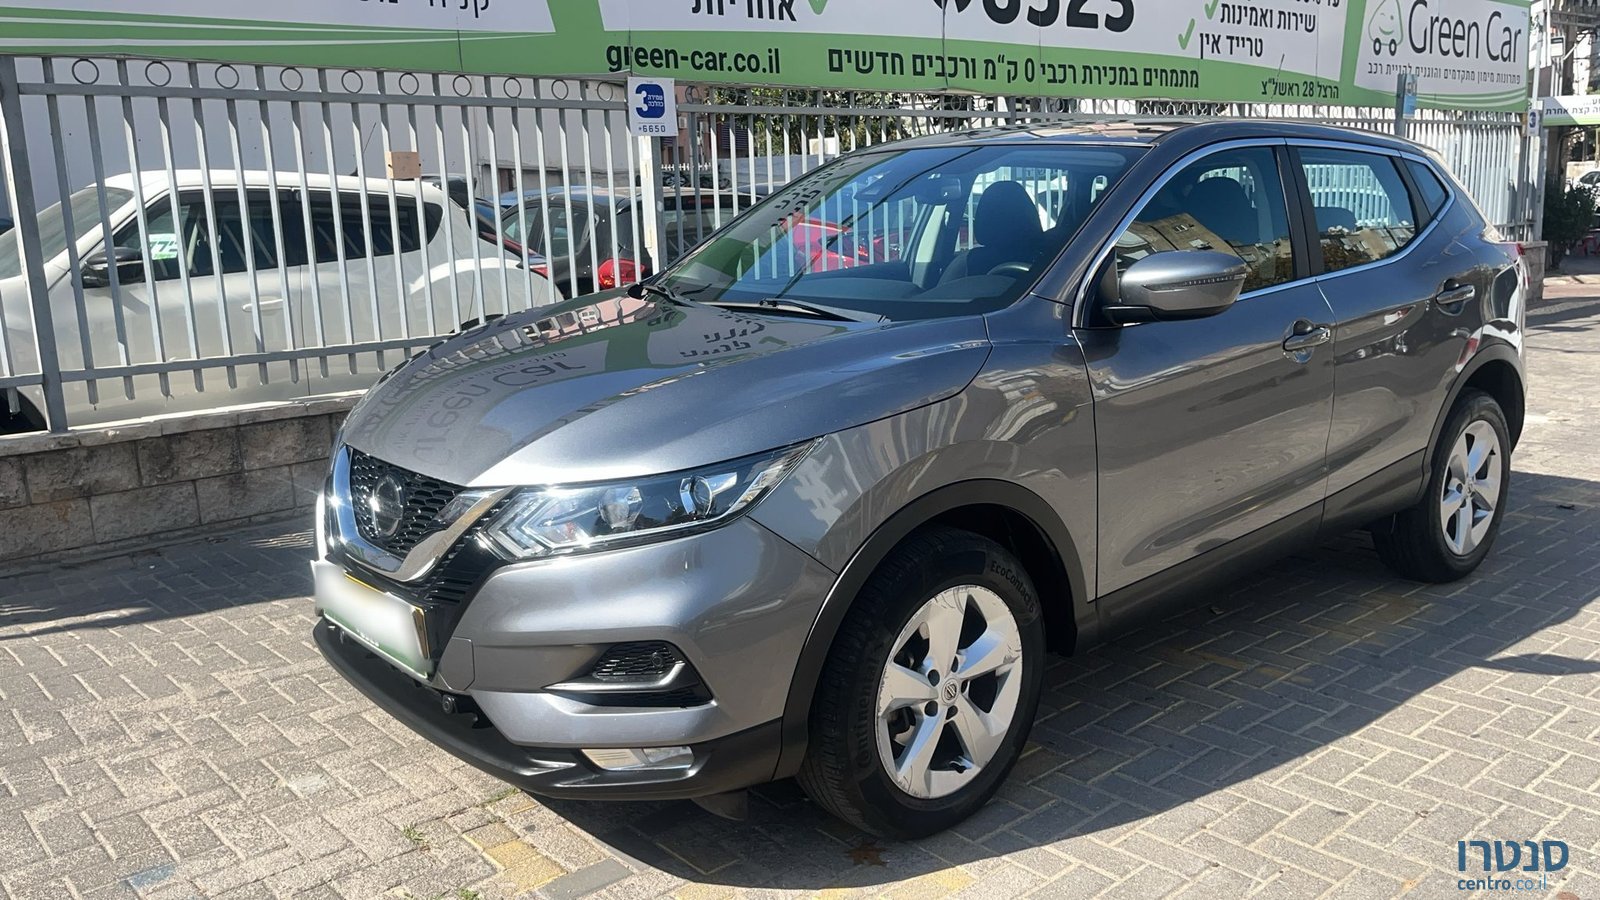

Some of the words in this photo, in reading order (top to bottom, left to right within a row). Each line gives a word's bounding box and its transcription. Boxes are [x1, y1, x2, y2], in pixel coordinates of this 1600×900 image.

[1220, 3, 1273, 28] ואמינות
[1277, 10, 1316, 33] שירות
[1408, 0, 1479, 58] Green
[1486, 11, 1521, 62] Car
[1200, 33, 1221, 59] אין
[1226, 35, 1263, 57] טרייד
[606, 45, 780, 74] green-car.co.il
[828, 49, 904, 75] חדשים
[912, 54, 976, 79] ורכבים
[1024, 58, 1035, 82] 0
[1368, 62, 1383, 75] רכב
[1040, 63, 1077, 84] רכבי
[1082, 65, 1138, 86] במכירת
[1143, 68, 1199, 88] מתמחים
[1302, 81, 1314, 97] 28
[1317, 80, 1339, 99] הרצל
